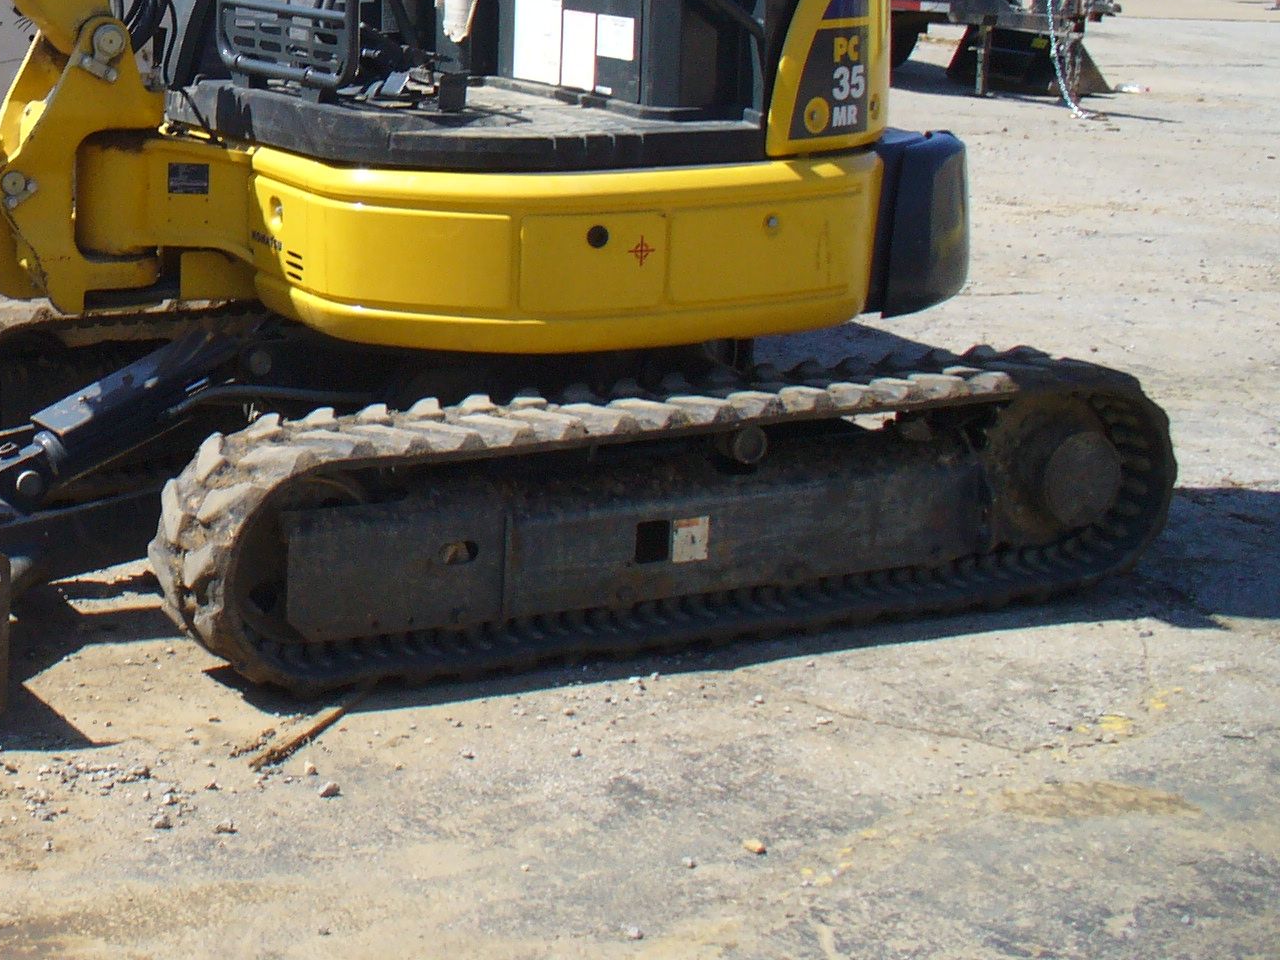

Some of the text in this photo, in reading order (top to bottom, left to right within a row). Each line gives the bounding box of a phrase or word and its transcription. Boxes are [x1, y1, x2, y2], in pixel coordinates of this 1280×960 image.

[833, 35, 860, 63] PC
[832, 64, 865, 100] 35
[832, 104, 858, 127] MR
